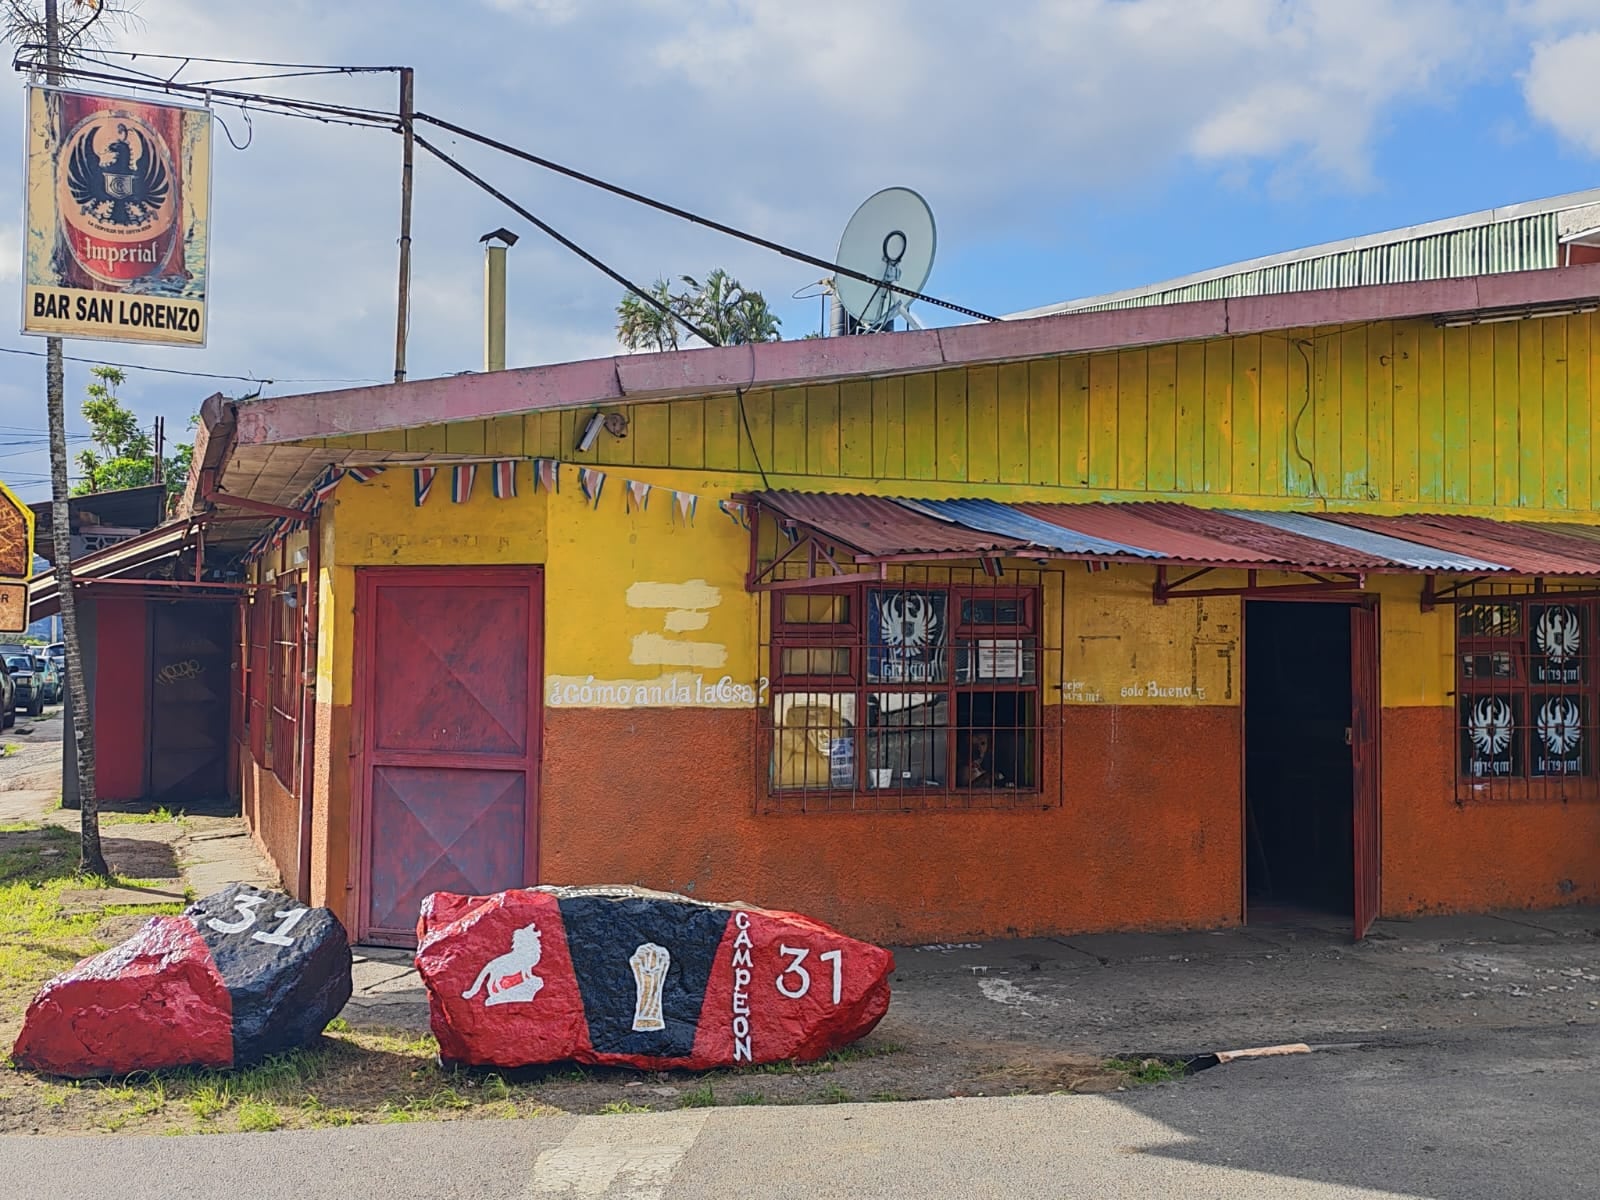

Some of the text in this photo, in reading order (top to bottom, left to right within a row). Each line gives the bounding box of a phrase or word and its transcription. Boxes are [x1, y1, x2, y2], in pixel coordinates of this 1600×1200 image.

[84, 236, 158, 273] Imperial
[33, 292, 200, 333] BAR SAN LORENZO
[634, 678, 691, 705] anda
[1120, 681, 1144, 697] solo
[206, 894, 309, 947] 31
[732, 911, 754, 1062] CAMPEON
[775, 943, 842, 1005] 31
